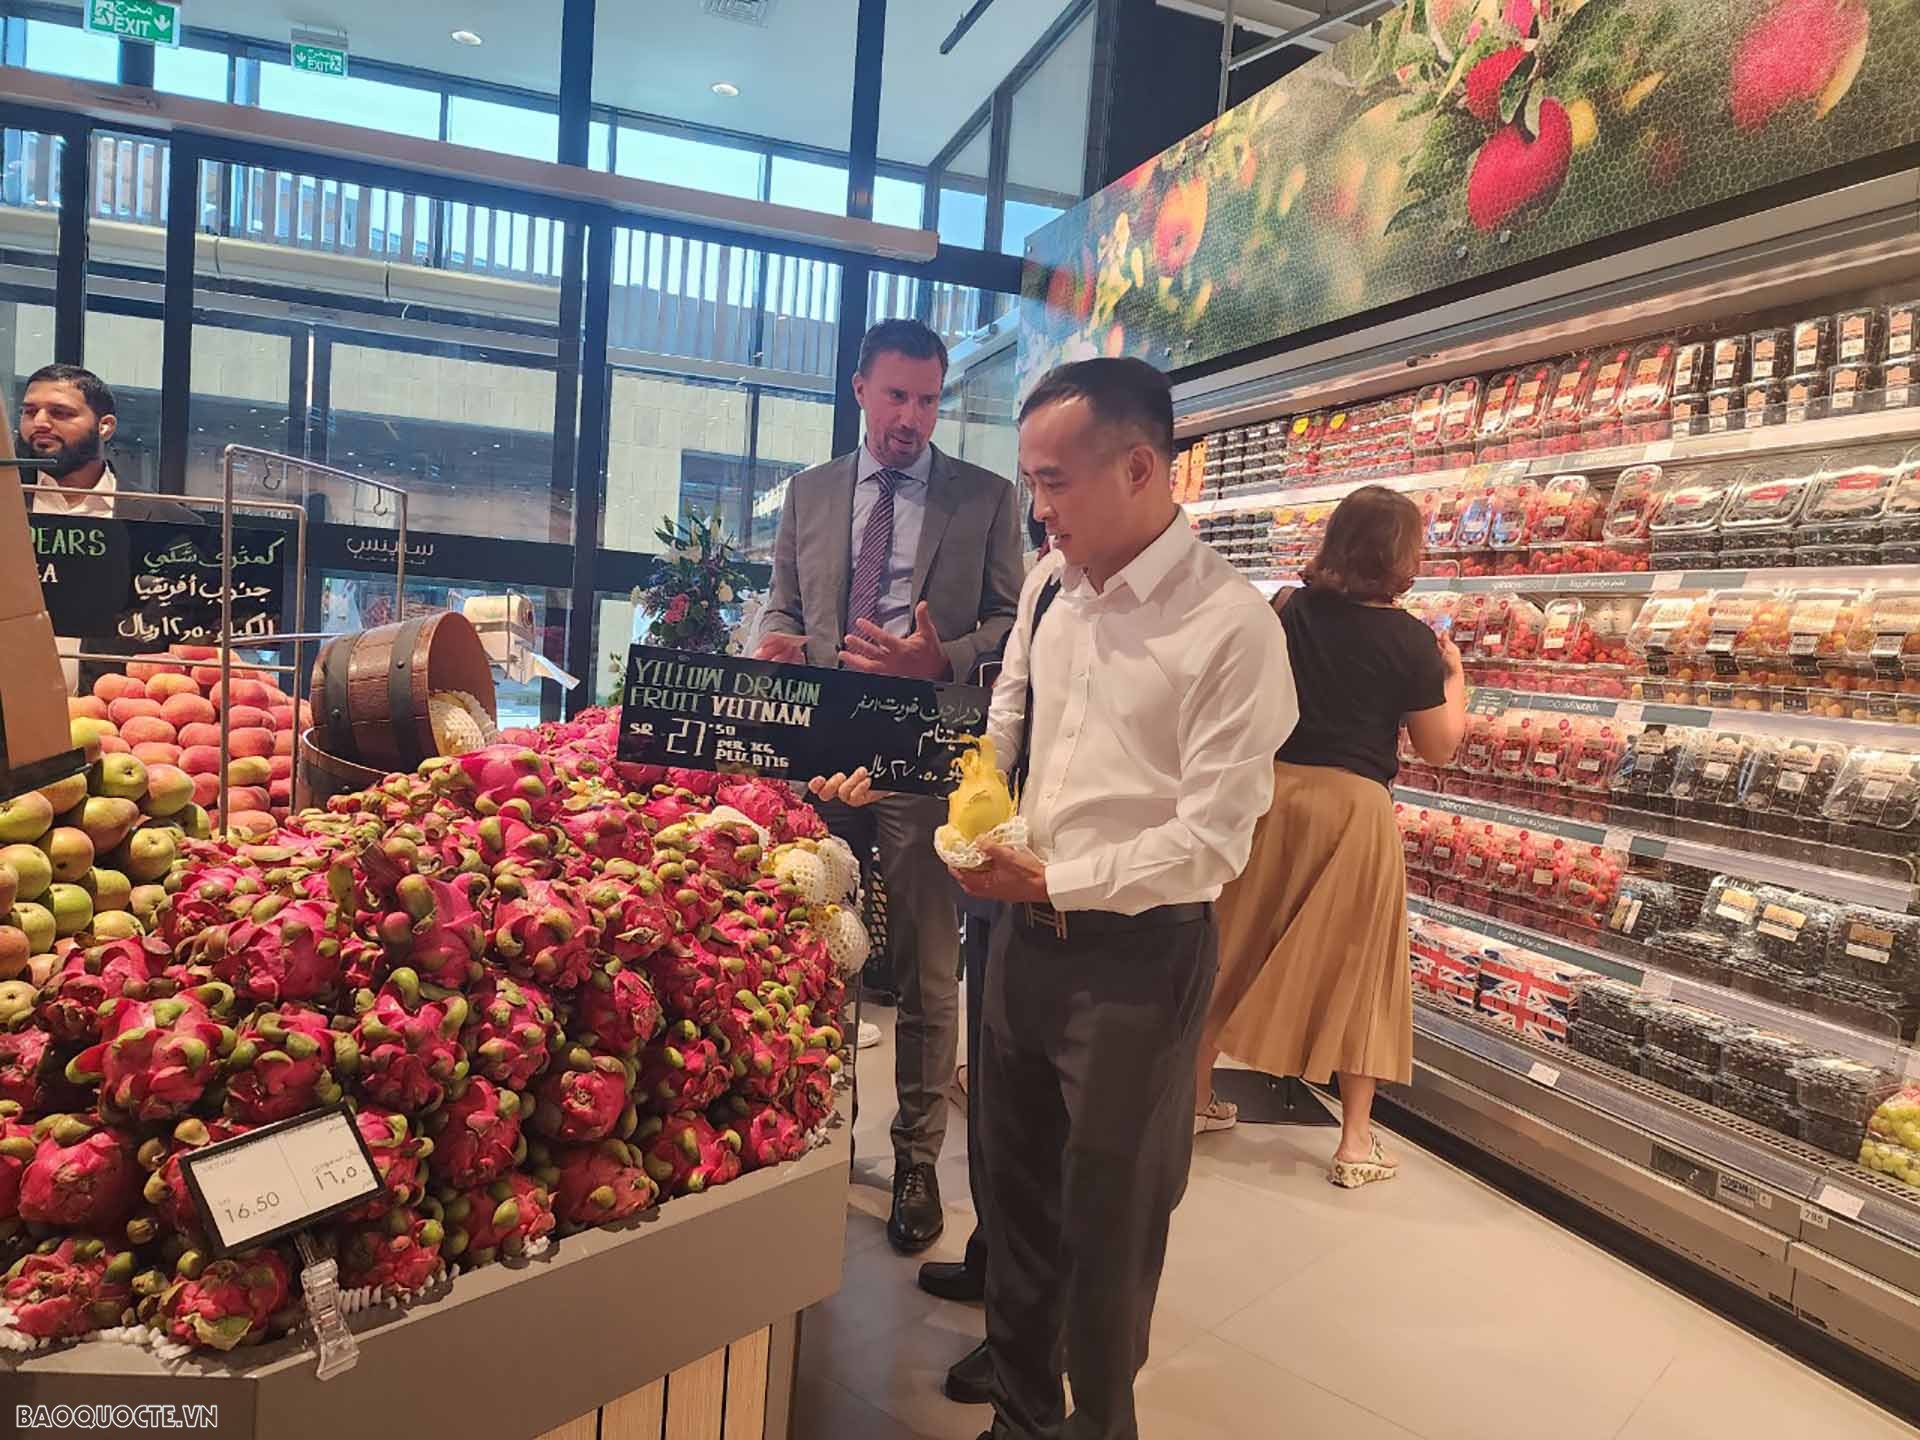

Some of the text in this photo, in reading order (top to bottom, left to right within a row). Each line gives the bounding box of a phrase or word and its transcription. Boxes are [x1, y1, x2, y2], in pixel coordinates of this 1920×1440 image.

[114, 16, 150, 36] EXIT
[308, 60, 330, 72] EXIT
[36, 563, 58, 583] A
[629, 687, 705, 713] FRUIT
[225, 1192, 280, 1223] 16.50
